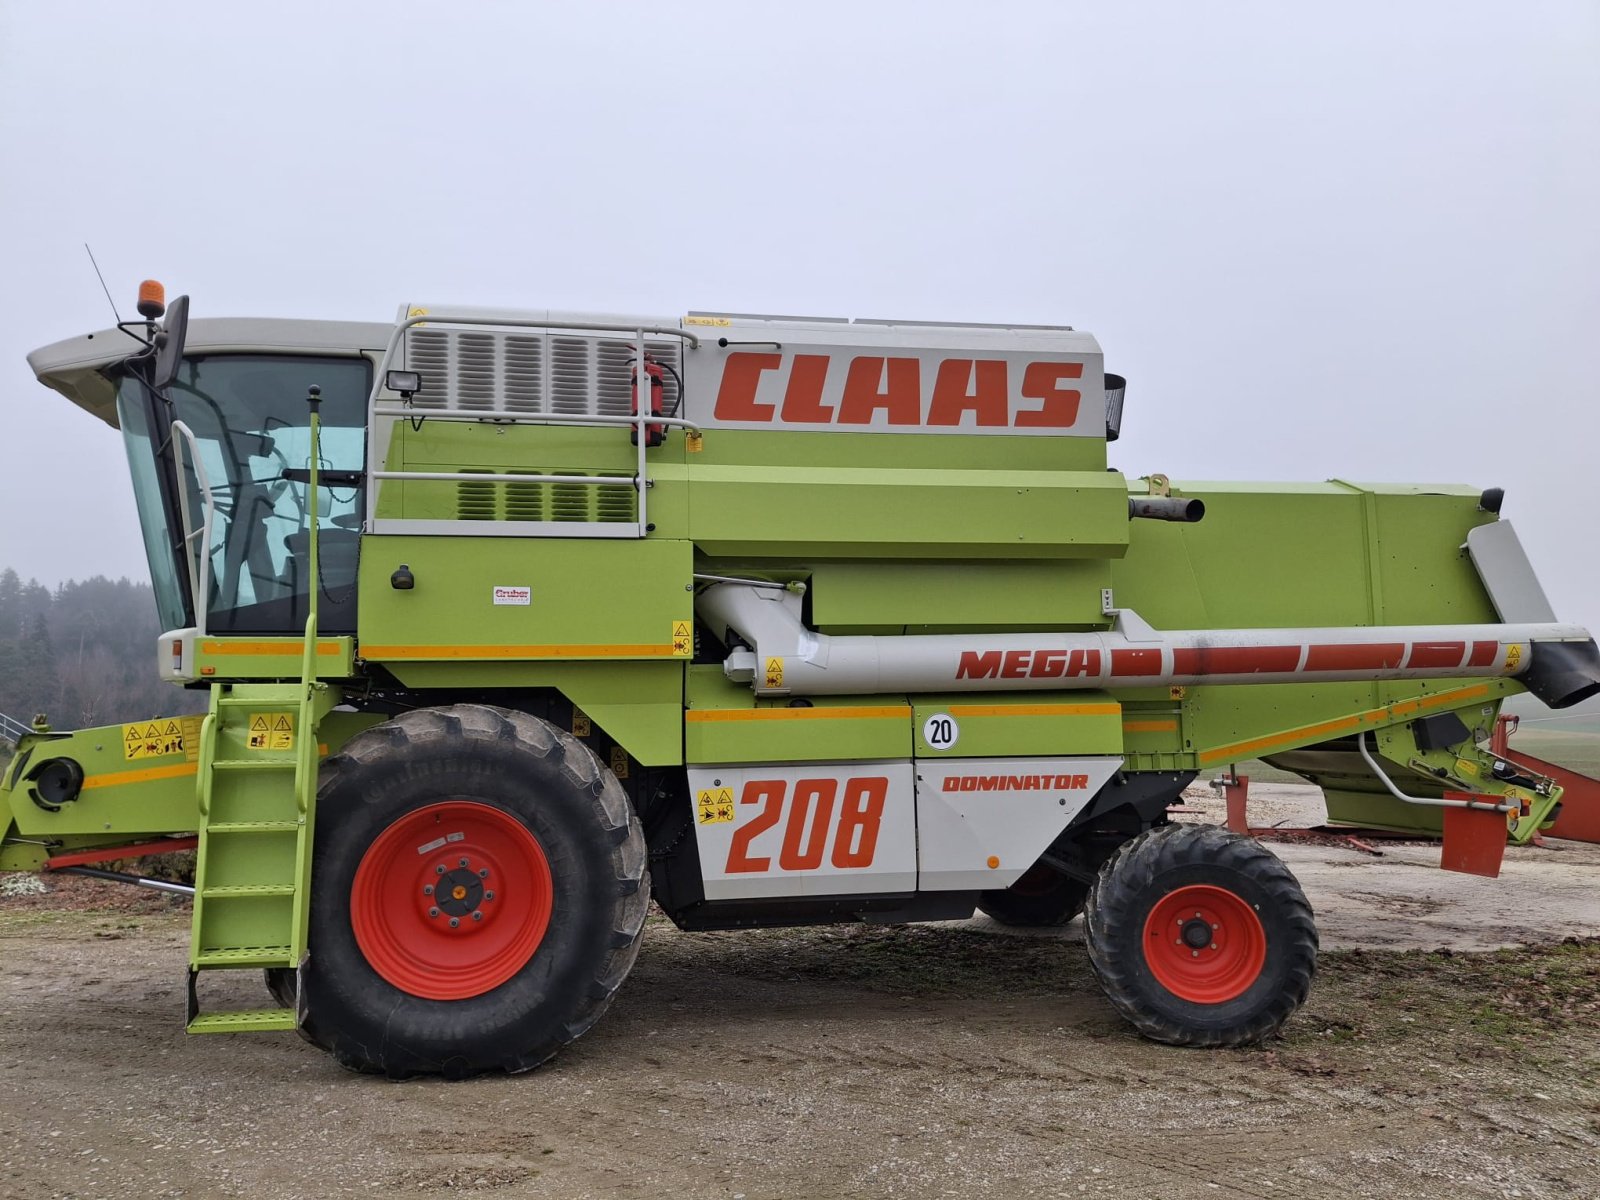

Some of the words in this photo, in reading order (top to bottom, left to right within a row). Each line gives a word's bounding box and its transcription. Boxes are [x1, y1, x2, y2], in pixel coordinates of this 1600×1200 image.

[714, 352, 1083, 428] CLAAS
[956, 649, 1101, 679] MEGA
[930, 719, 952, 744] 20
[942, 774, 1089, 793] DOMINATOR
[725, 776, 889, 874] 208
